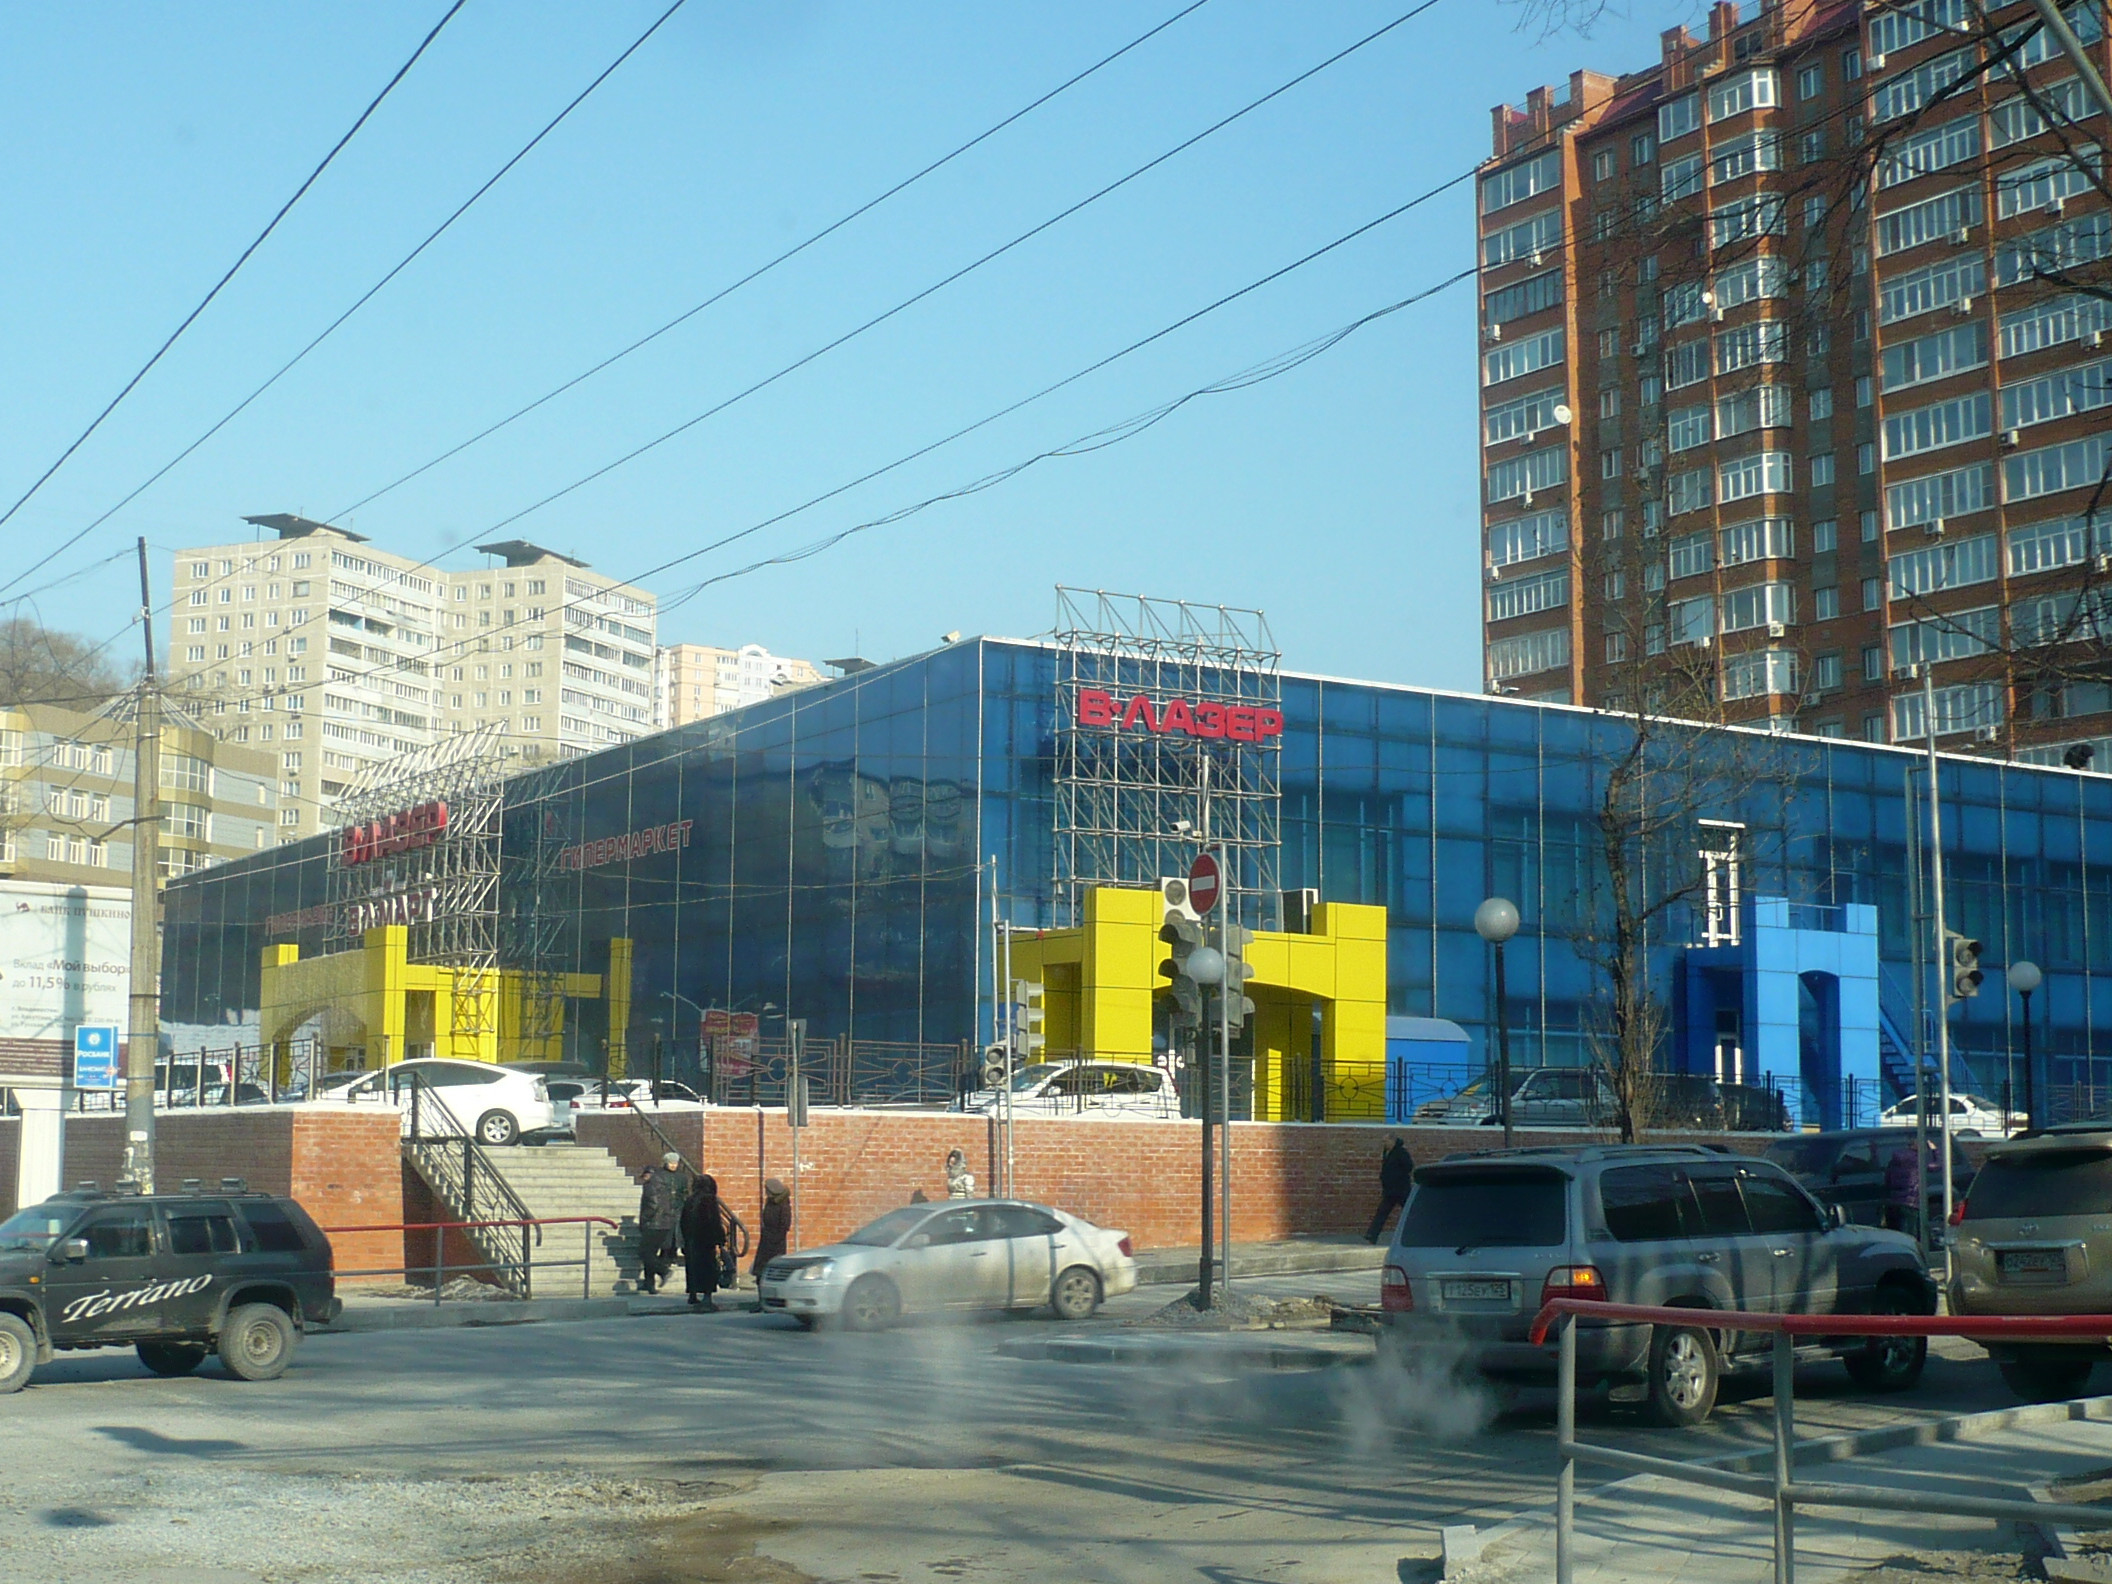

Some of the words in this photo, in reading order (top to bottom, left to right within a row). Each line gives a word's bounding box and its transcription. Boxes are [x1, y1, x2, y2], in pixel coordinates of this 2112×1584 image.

[560, 819, 694, 873] ГИПЕРМАРКЕТ
[13, 959, 44, 971] Вклад
[29, 976, 70, 990] 11,5%
[61, 1273, 213, 1323] Terriano
